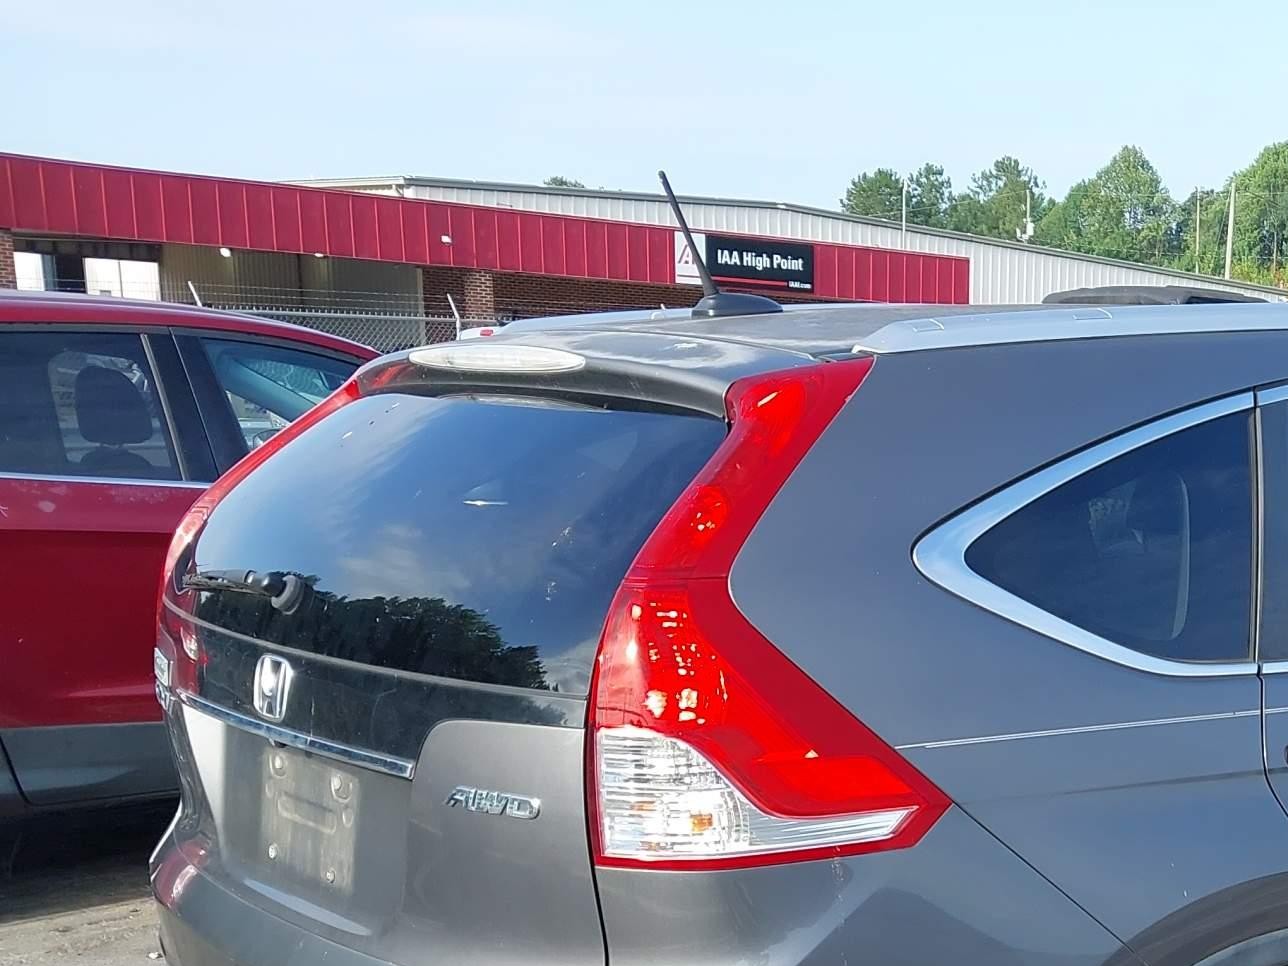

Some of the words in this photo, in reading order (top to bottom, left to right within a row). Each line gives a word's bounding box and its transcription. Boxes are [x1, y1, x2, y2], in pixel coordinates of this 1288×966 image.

[717, 249, 740, 266] IAA
[743, 252, 770, 270] High
[773, 255, 803, 271] Point
